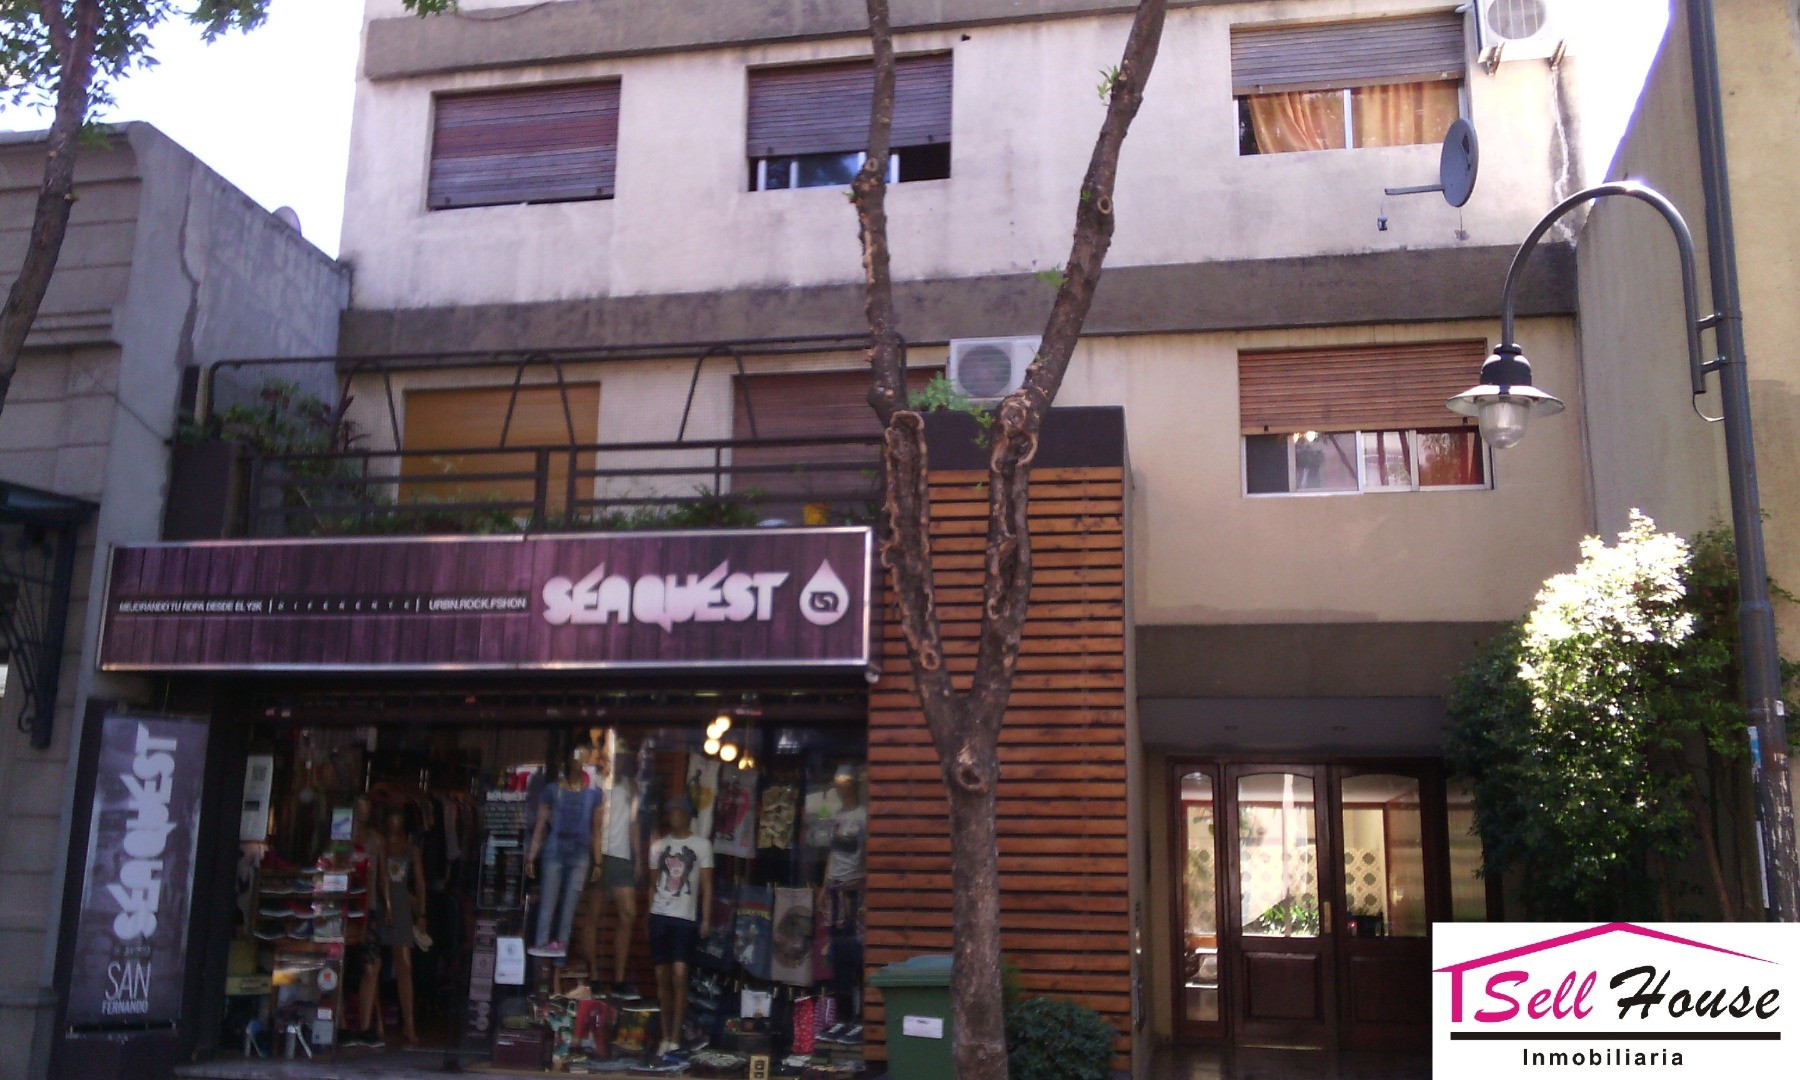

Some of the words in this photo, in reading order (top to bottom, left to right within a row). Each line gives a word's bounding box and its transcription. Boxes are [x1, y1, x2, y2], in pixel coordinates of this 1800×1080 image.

[182, 600, 205, 612] ROPA
[205, 600, 233, 612] DESDE
[234, 600, 245, 611] EL
[105, 960, 152, 1001] SAN
[102, 1000, 149, 1015] FERNANDO
